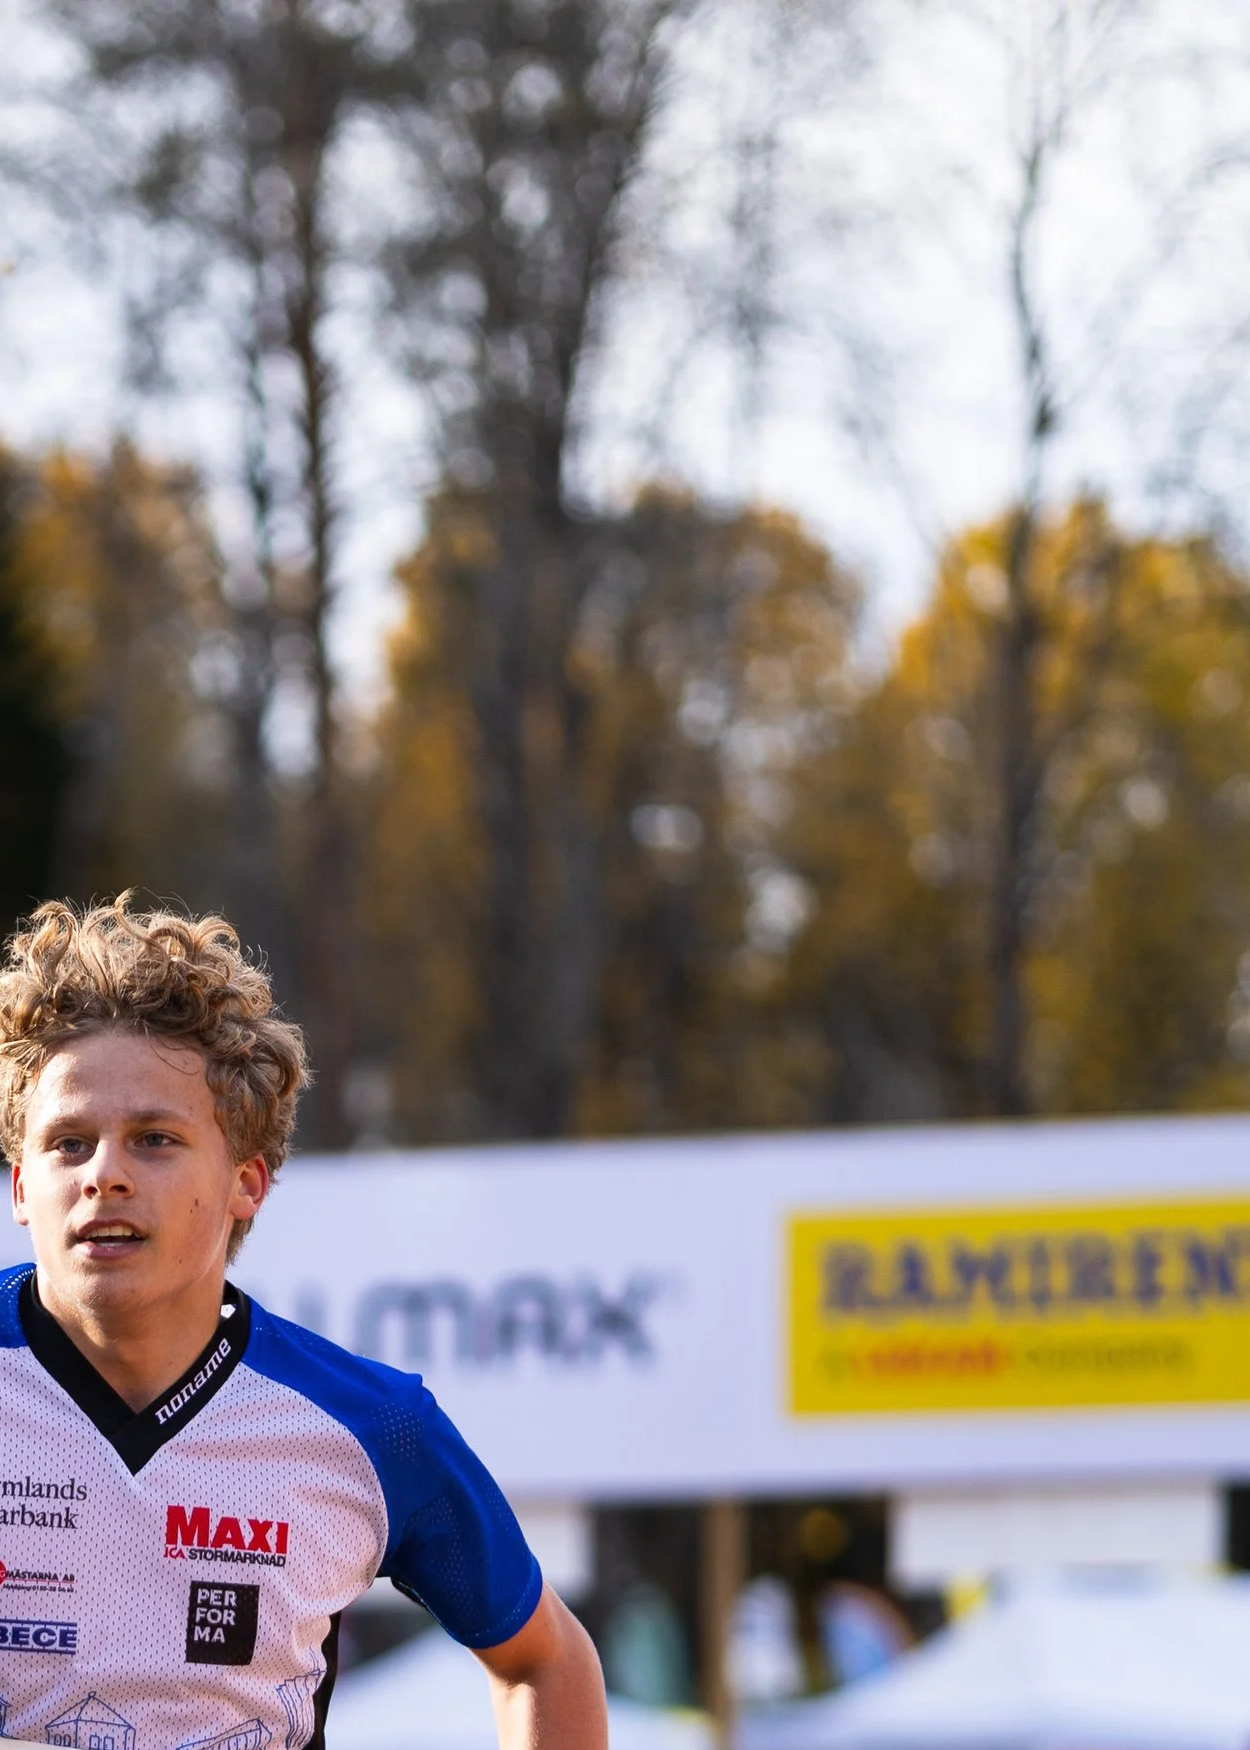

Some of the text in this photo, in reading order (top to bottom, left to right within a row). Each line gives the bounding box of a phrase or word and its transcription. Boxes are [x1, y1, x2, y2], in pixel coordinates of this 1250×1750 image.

[155, 1338, 231, 1424] noname
[165, 1505, 289, 1554] MAXI
[163, 1547, 287, 1568] ICA STORMARKNAD
[197, 1588, 237, 1607] PER
[195, 1607, 236, 1626] FOR
[193, 1625, 225, 1644] MA
